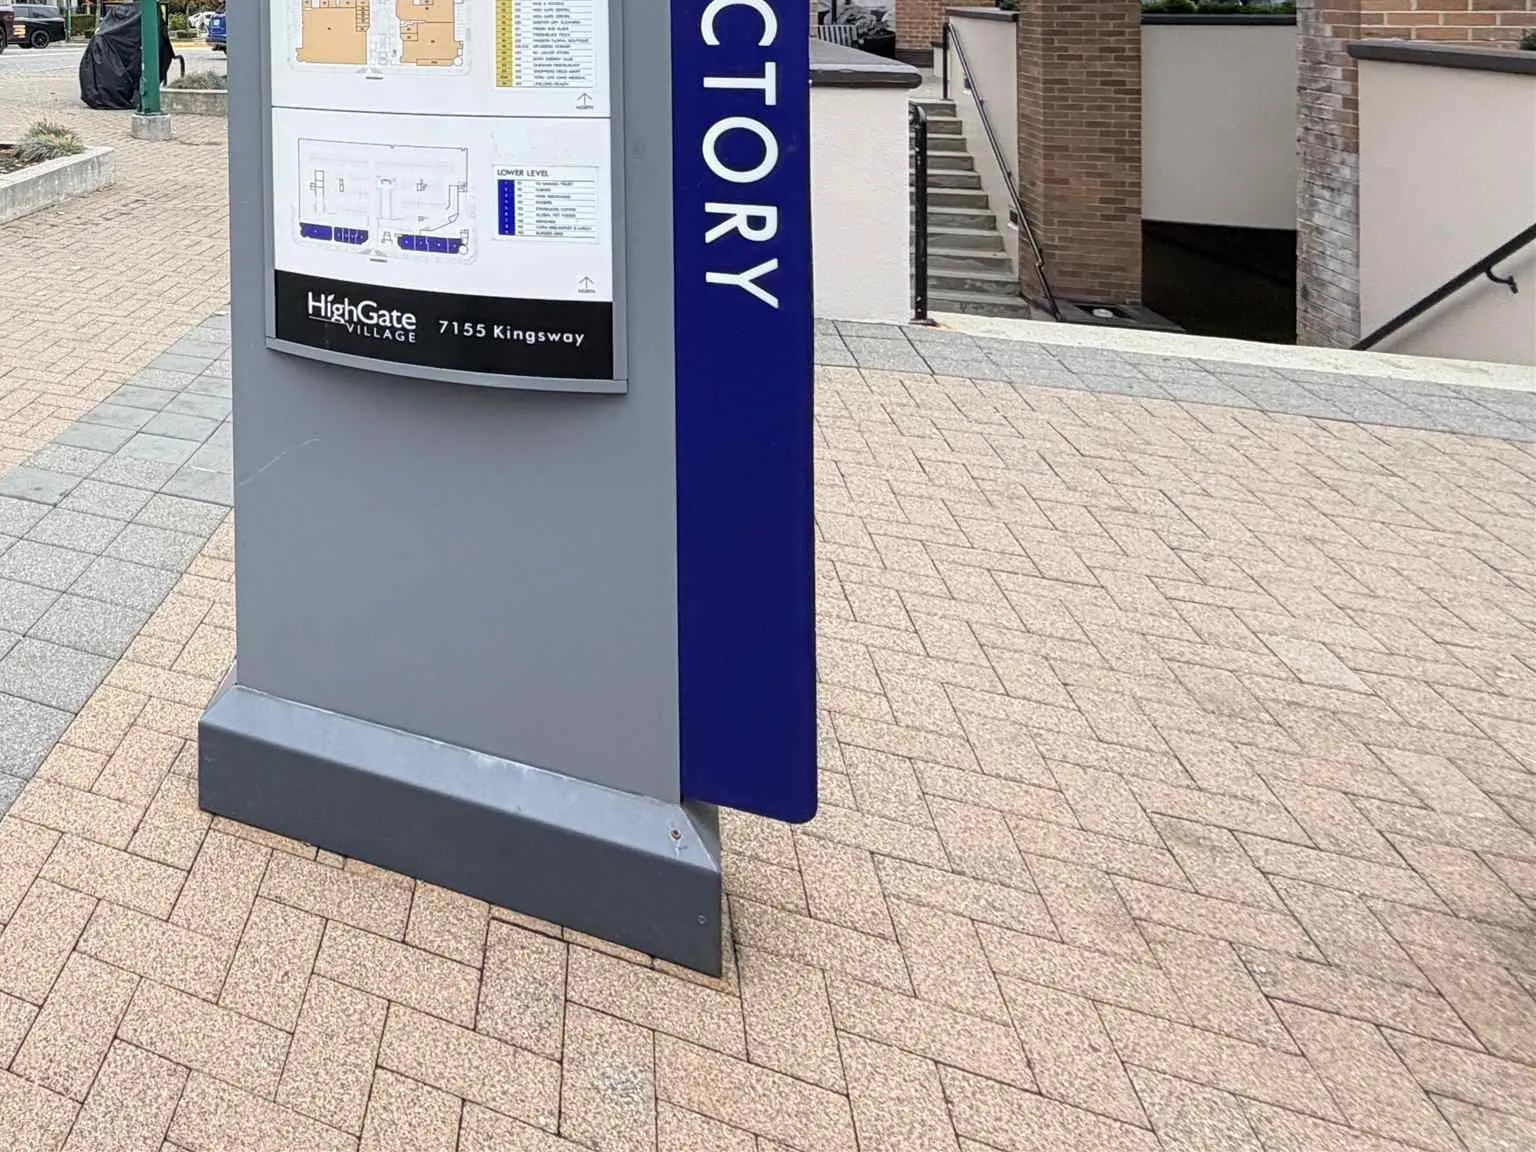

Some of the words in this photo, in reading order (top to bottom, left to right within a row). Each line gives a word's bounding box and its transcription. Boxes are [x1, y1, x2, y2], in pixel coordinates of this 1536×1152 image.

[497, 169, 524, 177] LOWER
[308, 291, 417, 329] HighGate
[346, 323, 417, 343] VILLAGE
[439, 320, 486, 338] 7155
[493, 325, 585, 347] Kingsway
